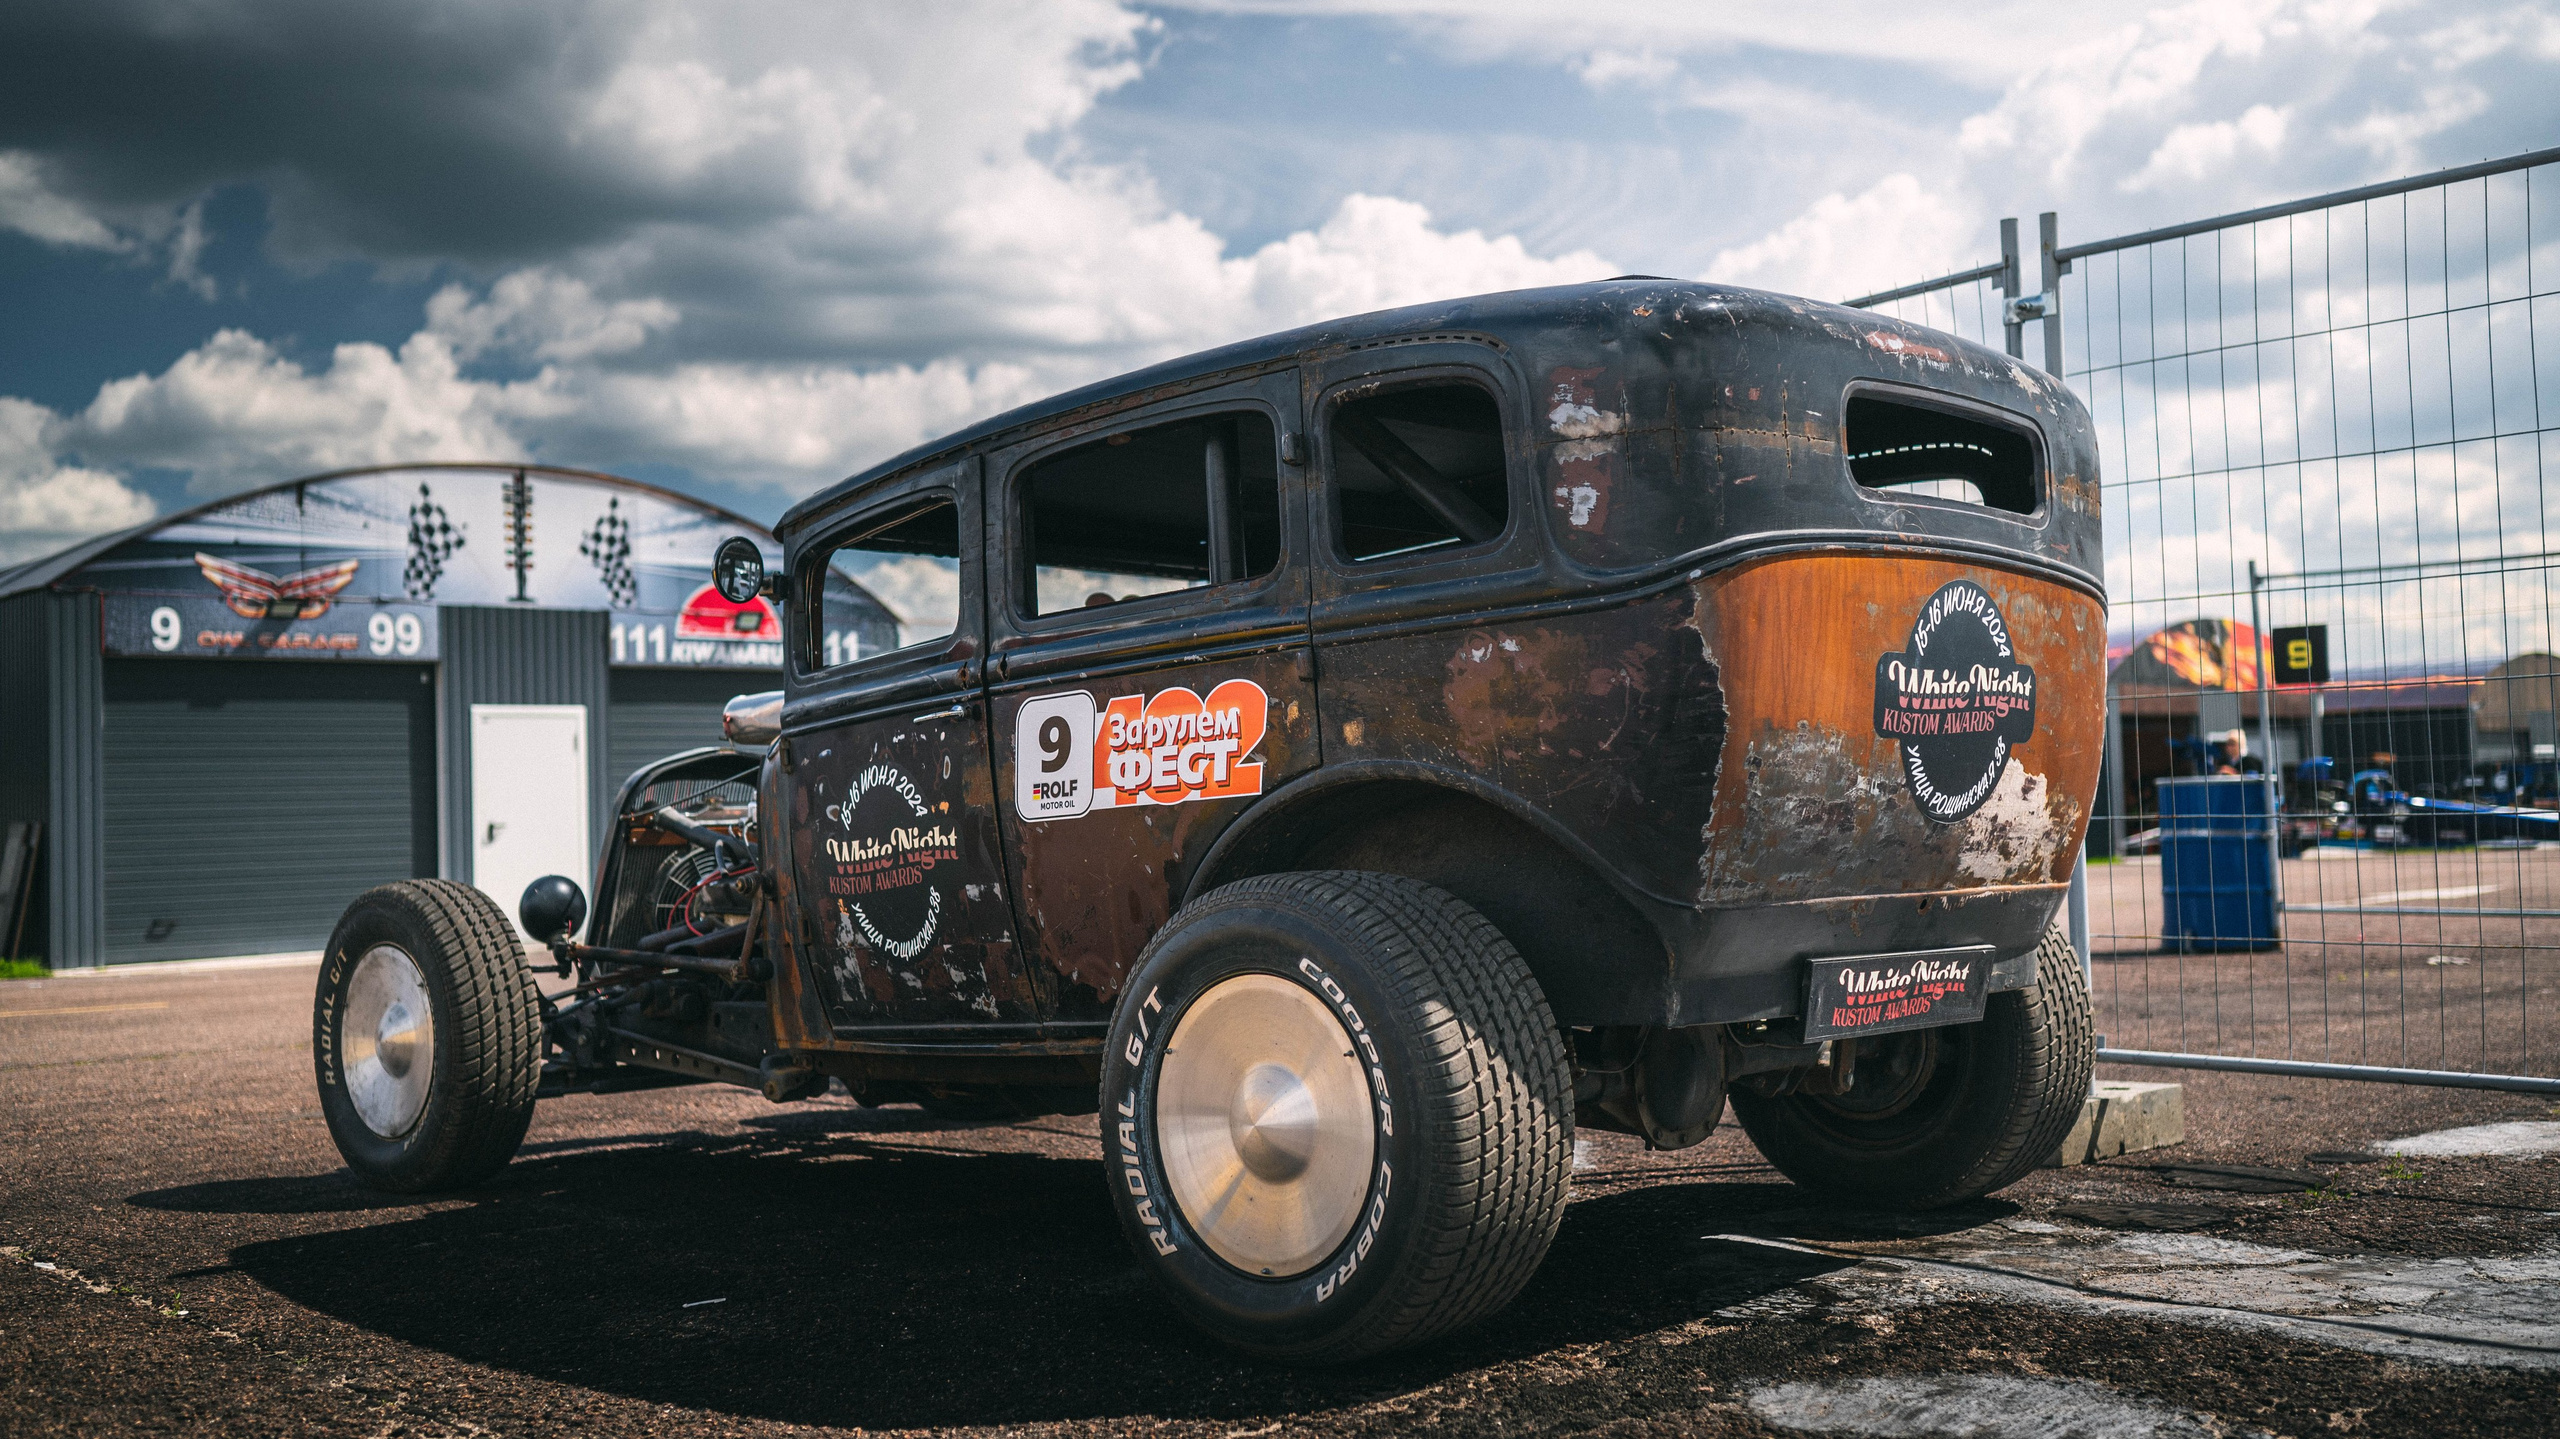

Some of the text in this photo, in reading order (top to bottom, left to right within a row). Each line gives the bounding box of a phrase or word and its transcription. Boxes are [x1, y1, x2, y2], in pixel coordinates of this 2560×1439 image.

[151, 606, 181, 651] 9
[257, 632, 359, 650] GARAGE
[368, 612, 421, 656] 99
[610, 623, 667, 662] 111
[1914, 586, 2011, 658] 15-16 ИЮНЯ 2024
[1888, 660, 2033, 718] White Night
[1038, 715, 1072, 773] 9
[1882, 708, 1996, 735] KUSTOM AWARDS
[1040, 779, 1078, 800] ROLF
[1107, 738, 1242, 796] ФЕСТ
[1907, 735, 2007, 818] УЛИЦА РОЩИНСКАЯ 38
[841, 765, 928, 831] 15-16 ИЮНЯ 2024
[1040, 800, 1076, 811] MOTOR OIL
[826, 825, 959, 875] White Night
[829, 866, 922, 895] KUSTOM AWARDS
[851, 885, 941, 961] УЛИЦА РОЩИНСКАЯ 38
[1838, 959, 1971, 1006] White Night
[321, 948, 347, 1085] RADIAL G/T
[1831, 996, 1931, 1027] KUSTOM AWARDS
[1117, 985, 1178, 1257] RADIAL G/T
[1299, 957, 1394, 1303] COOPER COBRA
